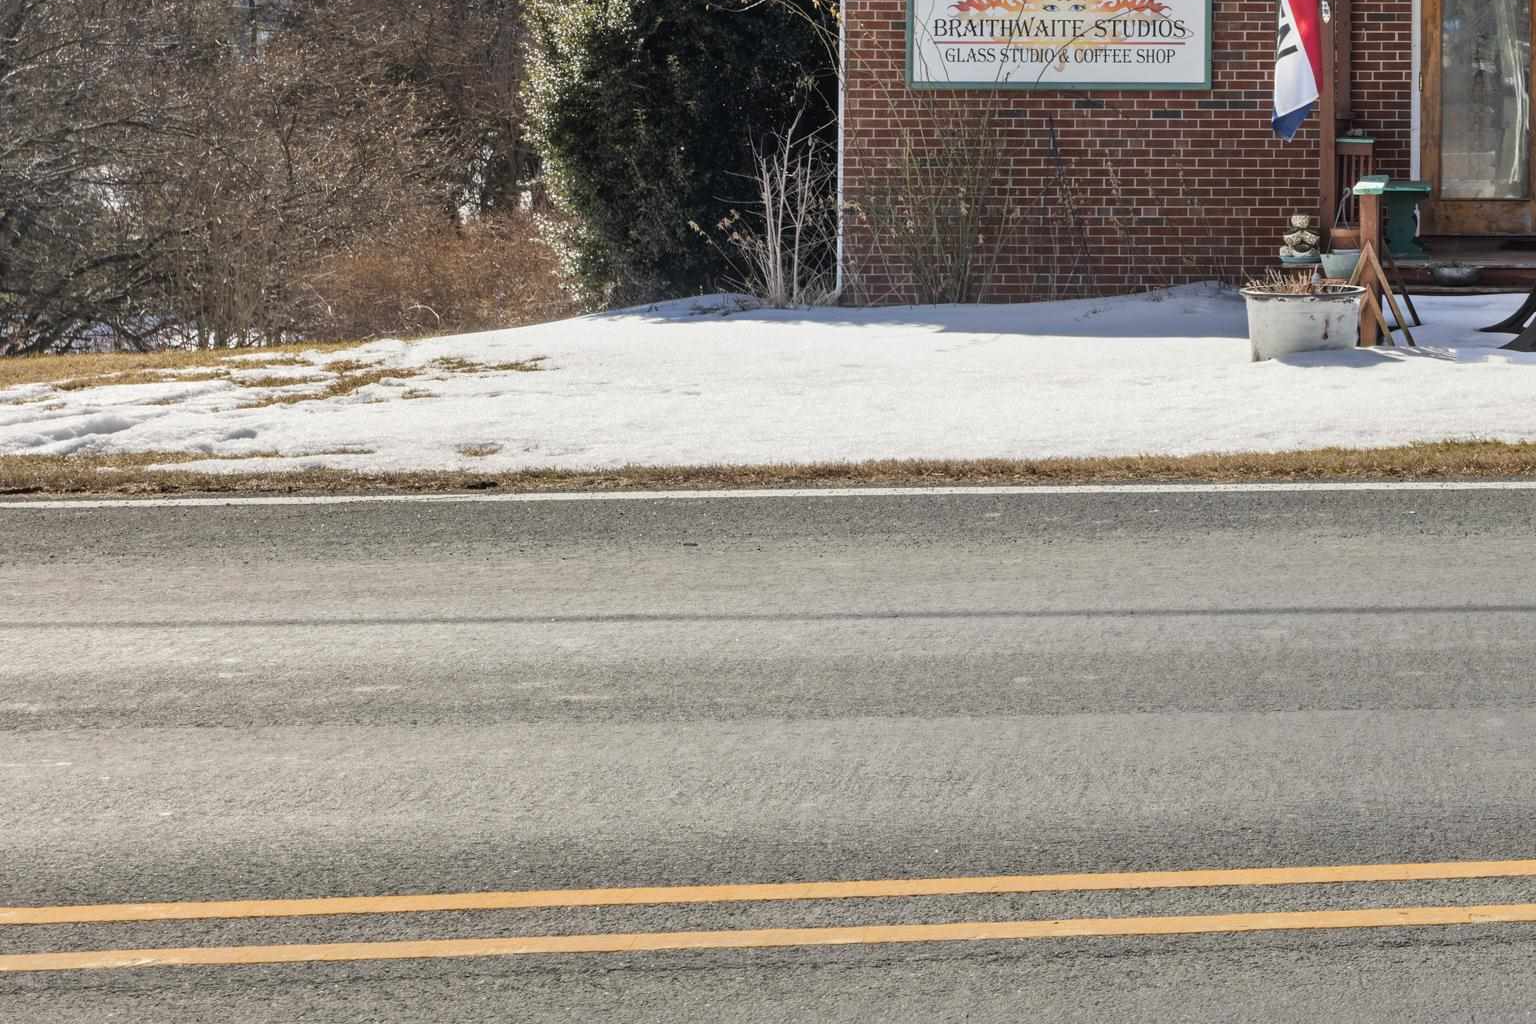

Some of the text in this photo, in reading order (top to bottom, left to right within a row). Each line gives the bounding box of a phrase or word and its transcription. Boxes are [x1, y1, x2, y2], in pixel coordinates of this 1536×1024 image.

[933, 17, 1187, 38] BRAITHWAITE STUDIOS
[945, 47, 1176, 64] GLASS STUDIO & COFFEE SHOP
